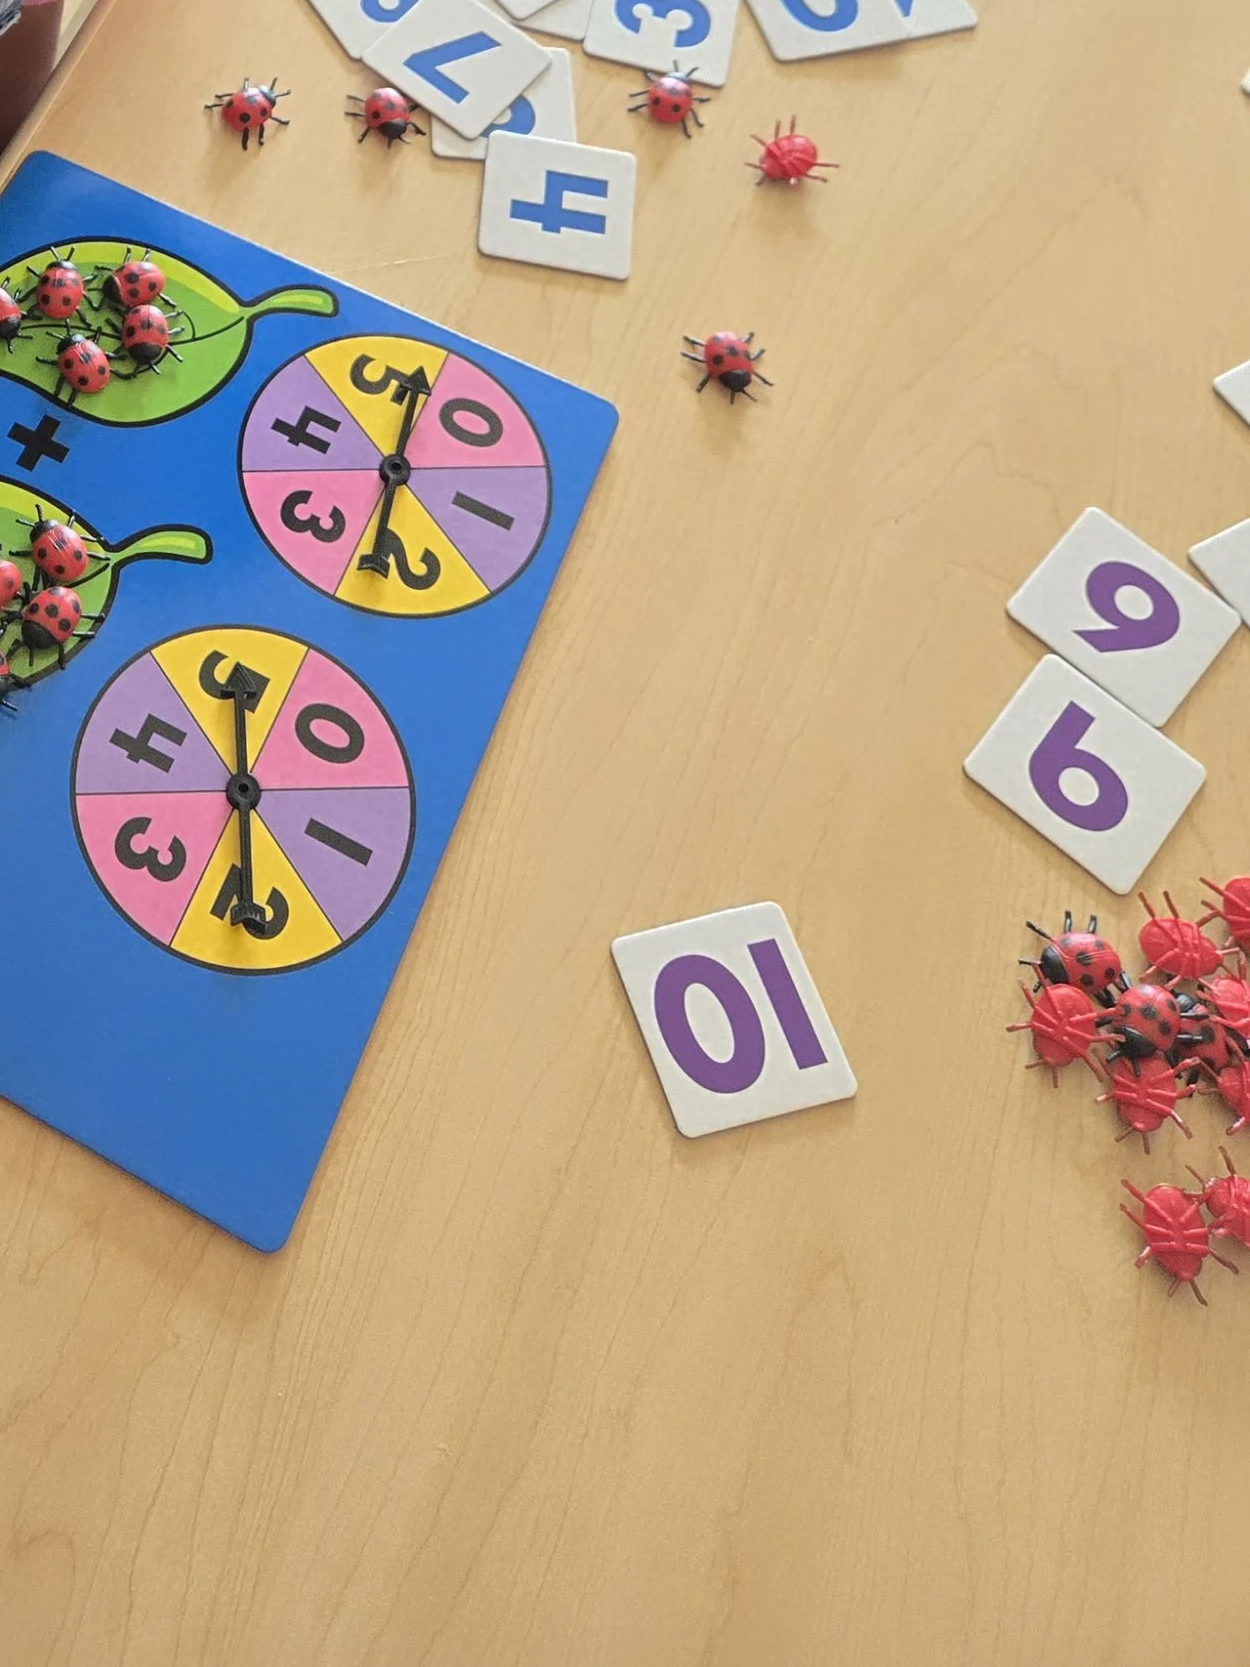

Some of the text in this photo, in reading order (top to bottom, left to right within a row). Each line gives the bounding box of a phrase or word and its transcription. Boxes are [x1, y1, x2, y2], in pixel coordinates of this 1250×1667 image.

[402, 31, 502, 105] 7
[509, 169, 609, 234] 4
[350, 353, 417, 407] 5
[270, 405, 342, 455] 4
[439, 397, 504, 447] 0
[280, 489, 347, 543] 3
[452, 492, 515, 531] 1
[362, 526, 441, 590] 2
[199, 649, 271, 714] 5
[109, 713, 188, 774] 4
[295, 702, 366, 765] 0
[113, 816, 188, 883] 3
[304, 817, 374, 867] 1
[209, 863, 290, 941] 2
[653, 938, 828, 1095] 10
